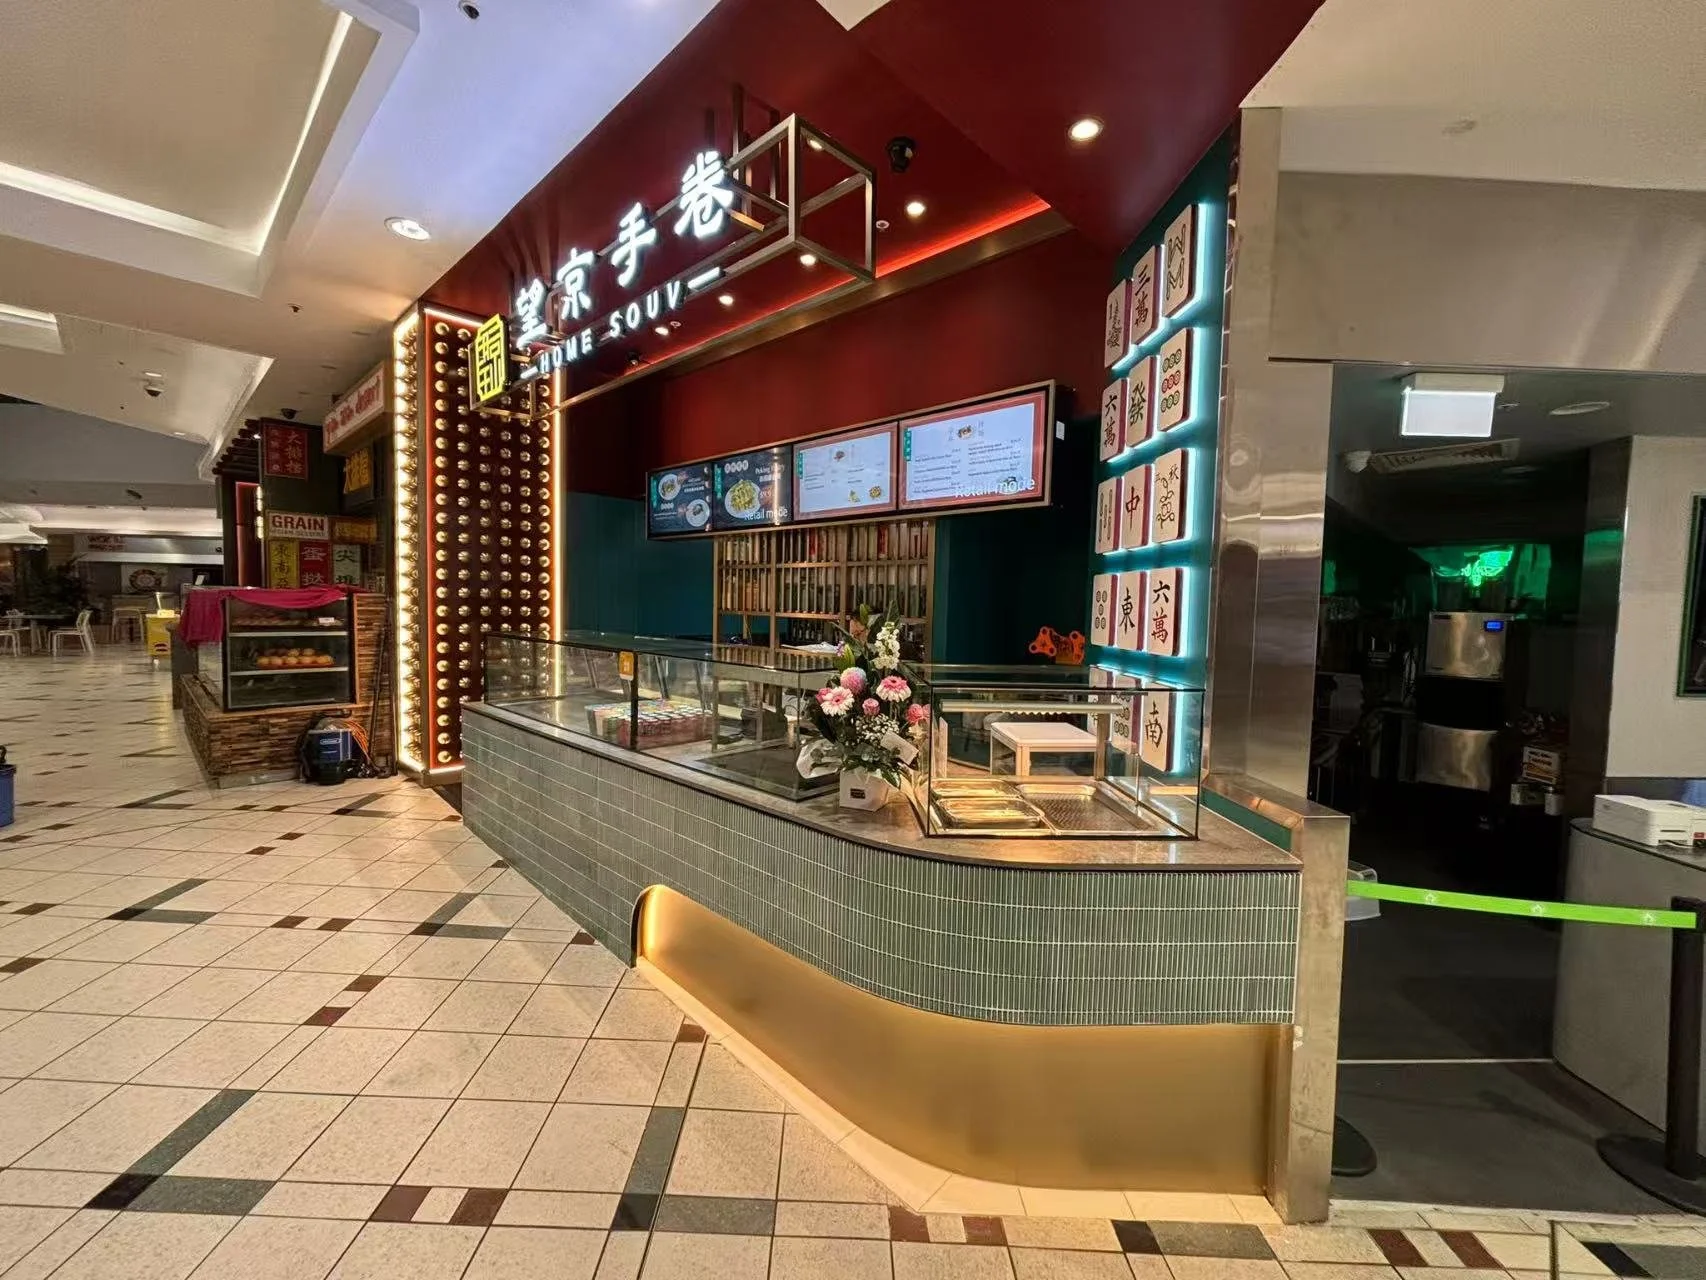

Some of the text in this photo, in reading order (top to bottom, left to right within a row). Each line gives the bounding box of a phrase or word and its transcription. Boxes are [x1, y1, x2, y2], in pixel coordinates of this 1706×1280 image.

[514, 149, 735, 349] 望京手卷
[1134, 264, 1151, 327] 三萬
[539, 327, 593, 374] HOME
[608, 279, 682, 338] SOUV
[271, 514, 325, 531] GRAIN
[1125, 486, 1141, 531] 中
[1118, 586, 1136, 635] 東
[1151, 579, 1171, 644] 六萬
[1144, 700, 1164, 749] 南
